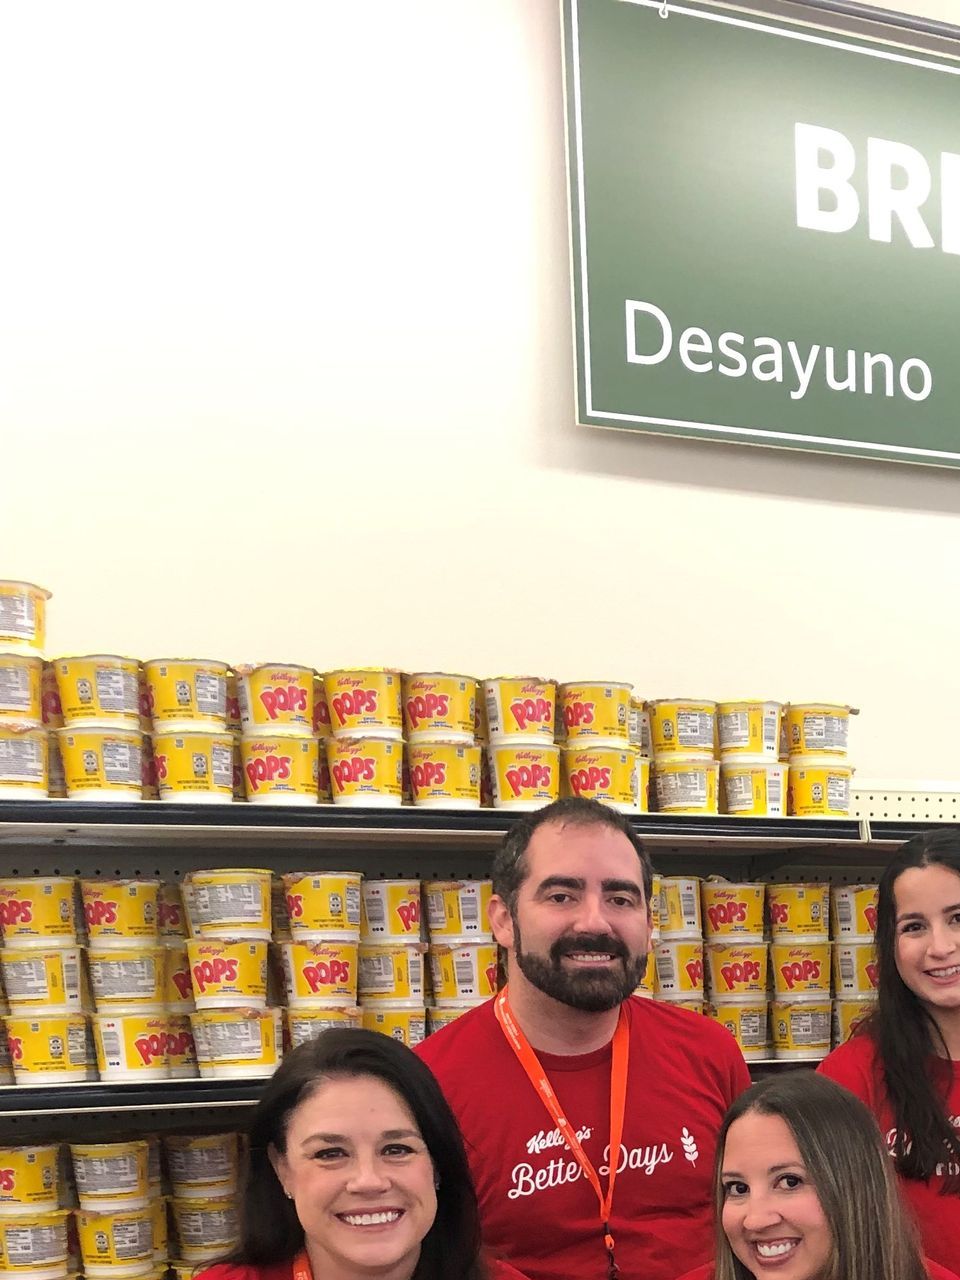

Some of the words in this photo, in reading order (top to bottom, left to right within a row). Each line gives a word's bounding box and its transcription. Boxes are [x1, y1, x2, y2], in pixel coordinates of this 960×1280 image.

[625, 299, 932, 401] Desayuno
[260, 686, 307, 720] POPS
[332, 689, 377, 726] POPS
[406, 693, 449, 728] POPS
[510, 698, 552, 730] POPS
[246, 756, 291, 792] POPS
[332, 757, 375, 792] POPS
[506, 764, 551, 797] POPS
[570, 766, 611, 797] POPS
[0, 900, 32, 926] OPS
[708, 902, 747, 932] POPS
[193, 958, 238, 993] POPS
[303, 960, 349, 992] POPS
[721, 961, 760, 990] POPS
[780, 960, 821, 990] POPS
[526, 1126, 591, 1154] Kellog's
